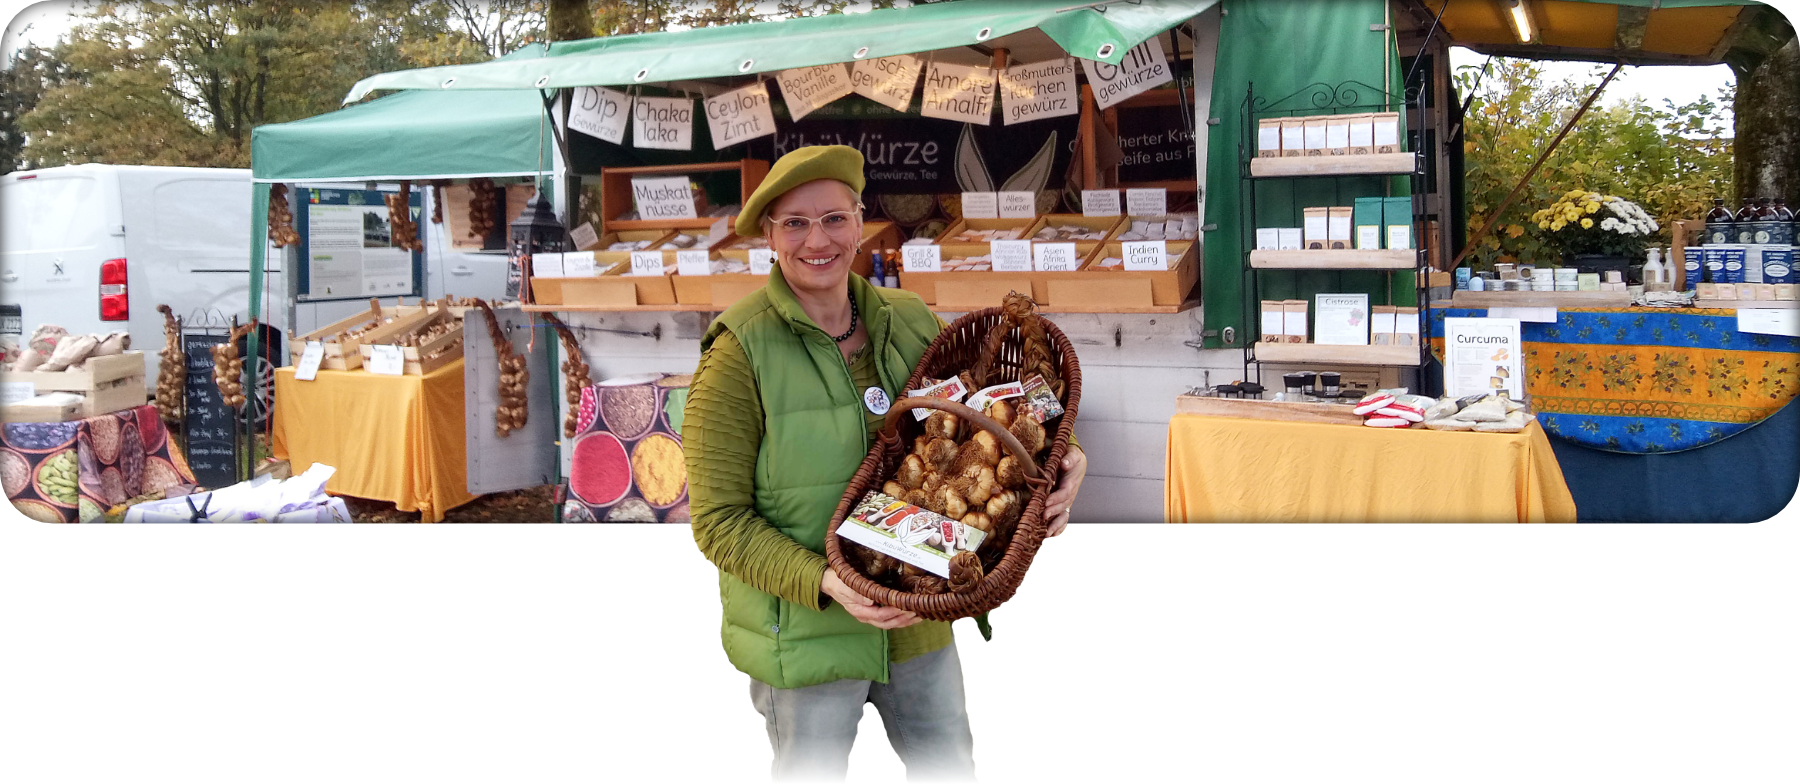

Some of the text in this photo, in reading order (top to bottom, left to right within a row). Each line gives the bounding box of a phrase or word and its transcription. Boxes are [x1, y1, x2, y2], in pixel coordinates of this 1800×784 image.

[793, 73, 837, 102] Vanille
[927, 67, 992, 95] Amore
[1099, 64, 1164, 103] gewürze
[581, 86, 618, 123] Dip
[635, 100, 690, 123] Chaka
[707, 92, 766, 120] Ceylon
[1011, 97, 1068, 122] gewürz
[643, 121, 679, 143] laka
[721, 114, 761, 142] Zimt
[1155, 149, 1182, 163] aus
[635, 184, 691, 202] Muskat
[645, 201, 689, 217] nüsse
[907, 249, 934, 258] Grill &
[1128, 245, 1159, 255] Indien
[634, 254, 661, 271] Dips
[911, 258, 932, 269] BBQ
[1043, 255, 1066, 263] Afrika
[1043, 263, 1067, 271] Orient
[1130, 255, 1158, 265] Curry
[1325, 298, 1359, 306] Cistrose
[1457, 334, 1509, 344] Curcuma
